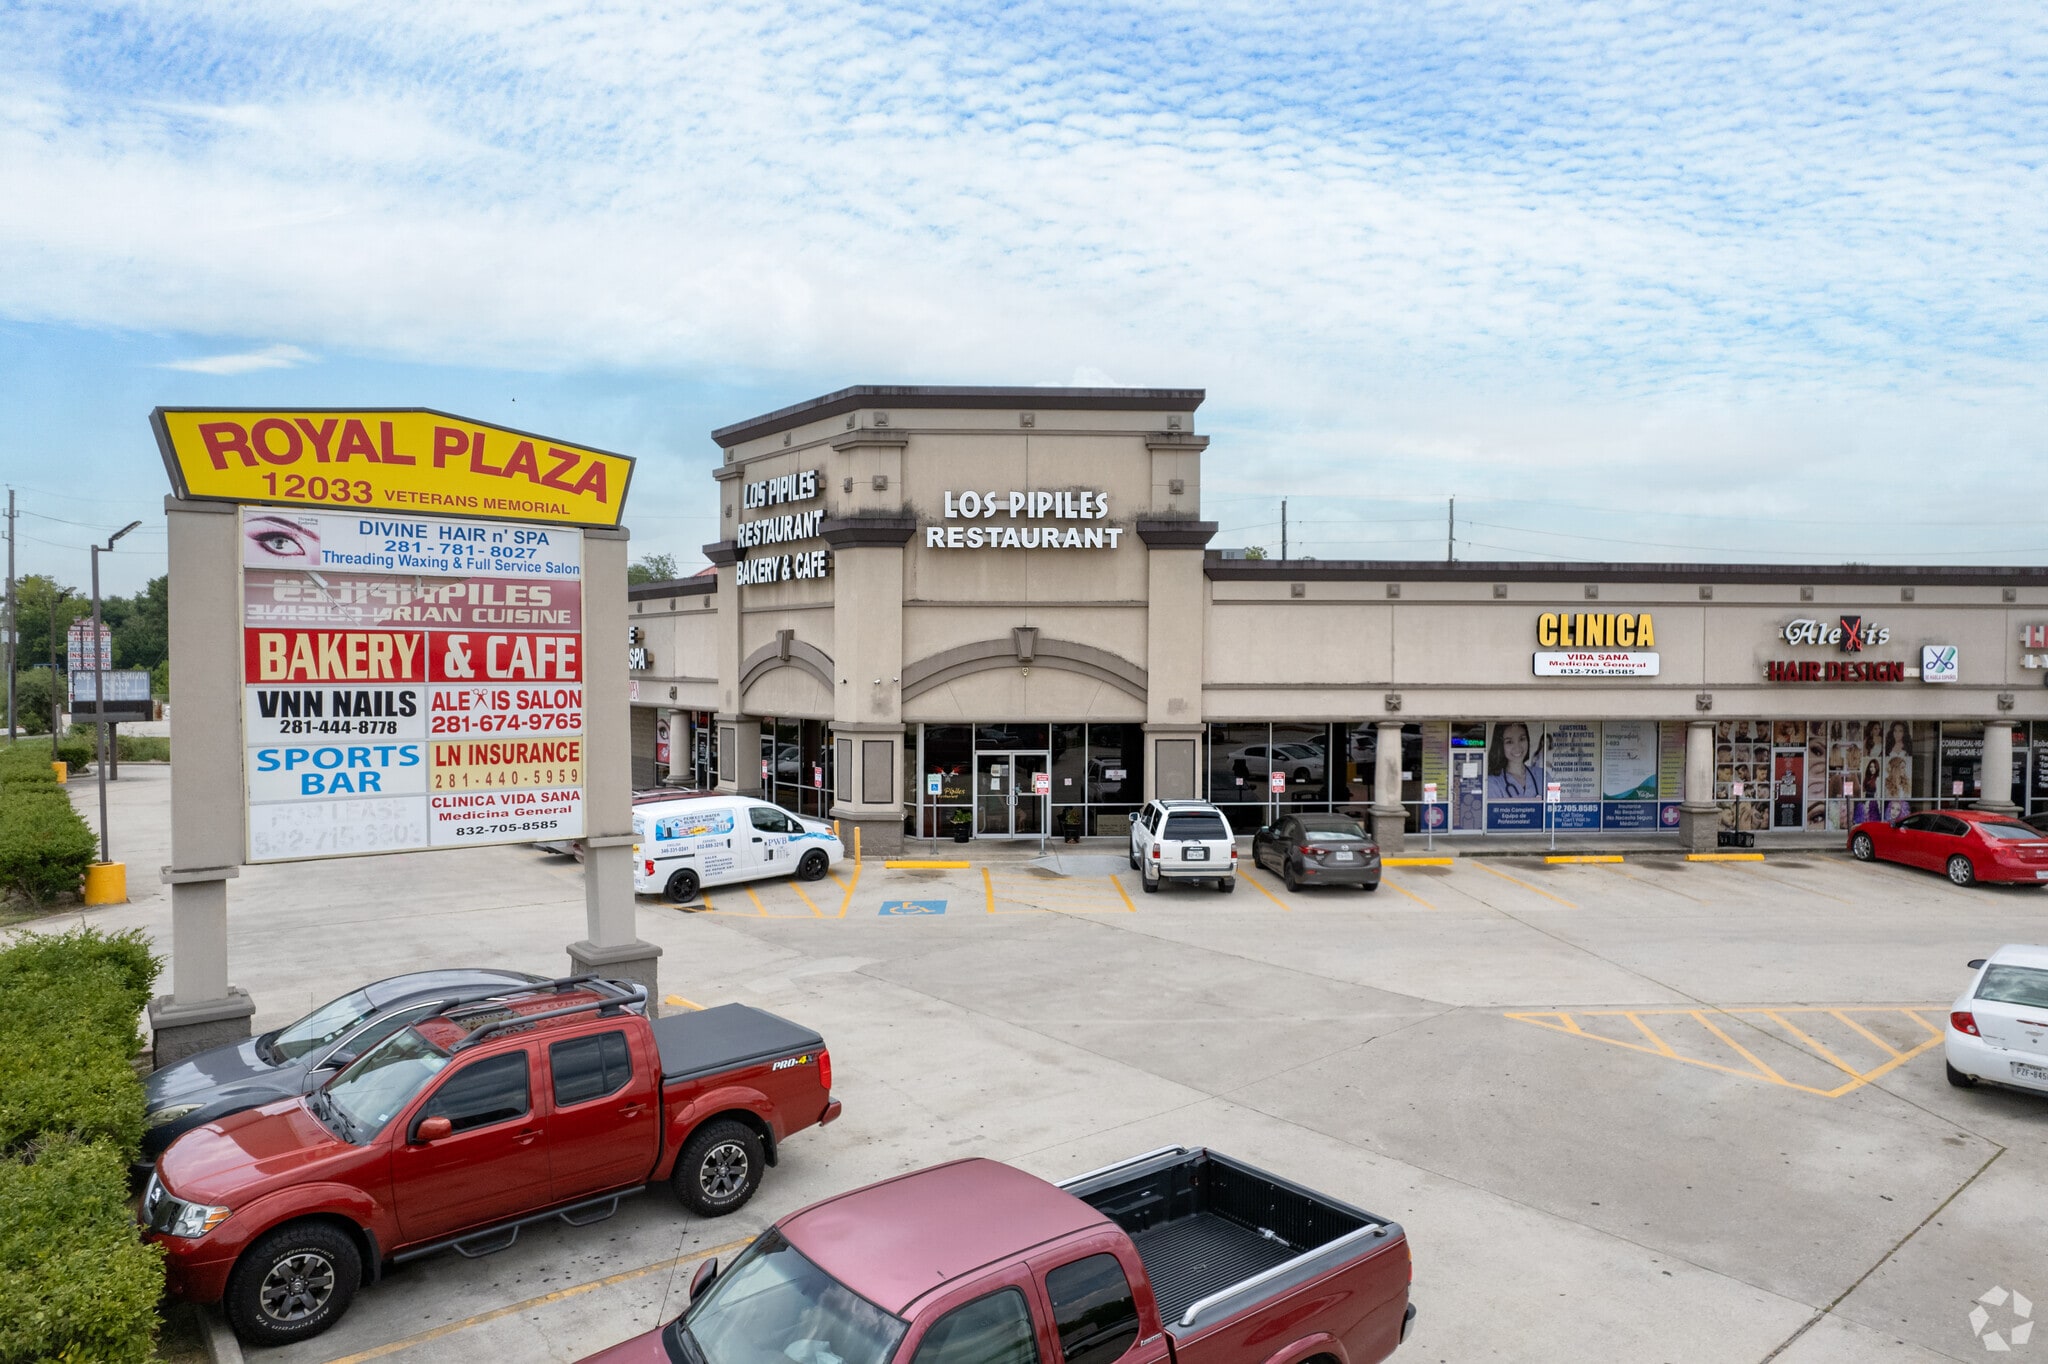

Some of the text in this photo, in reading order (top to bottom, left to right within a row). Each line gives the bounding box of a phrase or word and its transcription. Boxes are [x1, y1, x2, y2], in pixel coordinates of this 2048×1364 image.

[198, 418, 607, 504] ROYAL PLAZA
[262, 471, 570, 515] 12033 VETERANS MEMORIAL
[743, 469, 816, 509] LOS PIPILES
[944, 490, 1108, 519] LOS PIPILES
[359, 520, 427, 538] DIVINE
[439, 525, 486, 542] HAIR
[514, 530, 550, 546] SPA
[737, 509, 824, 549] RESTAURANT
[926, 526, 1124, 549] RESTAURANT
[384, 540, 420, 553] 281
[491, 546, 537, 559] 8027
[322, 550, 580, 575] Threading Waxing & Full Service Salon
[736, 550, 826, 586] BAKERY & CAFE
[472, 608, 571, 624] CUISINE
[1537, 612, 1655, 647] CLINICA
[259, 632, 576, 680] BAKERY & CAFE
[629, 648, 645, 670] SPA
[1767, 661, 1904, 682] HAIR DESIGN
[257, 690, 417, 718] VNN NAILS
[516, 689, 582, 710] SALON
[280, 719, 397, 735] 281-444-8778
[431, 713, 582, 734] 281-674-9765
[257, 745, 420, 771] SPORTS
[435, 741, 580, 767] LN INSURANCE
[301, 771, 382, 796] BAR
[431, 790, 581, 808] CLINICA VIDA SANA
[439, 805, 572, 821] Medicina General
[456, 820, 558, 836] 832-705-8585
[768, 837, 788, 847] PWB
